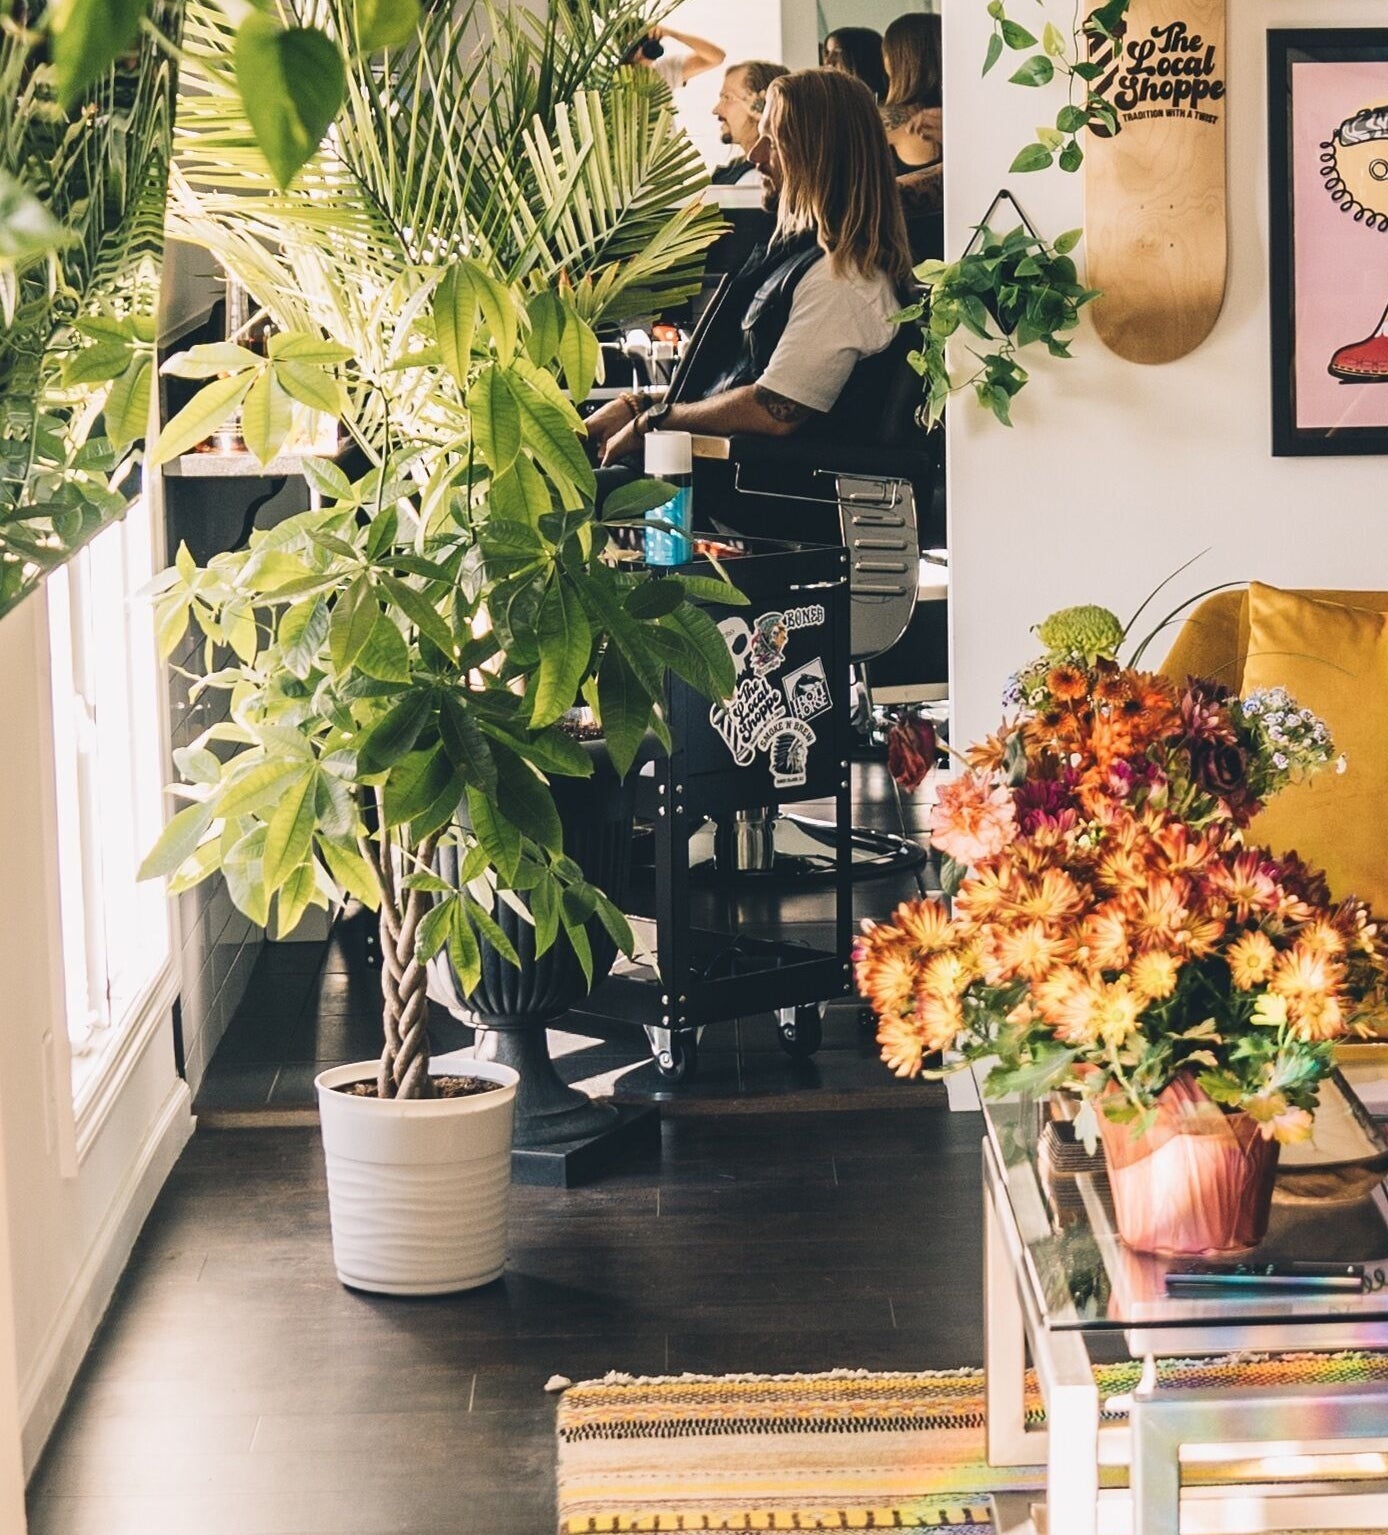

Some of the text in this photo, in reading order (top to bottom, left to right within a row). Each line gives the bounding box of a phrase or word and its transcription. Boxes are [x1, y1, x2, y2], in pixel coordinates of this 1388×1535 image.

[1151, 21, 1203, 53] The
[1126, 39, 1215, 77] Local
[1114, 75, 1226, 111] Shoppe
[1122, 108, 1218, 124] TRADITION WITH A TWIST
[733, 680, 769, 725] Local
[737, 680, 760, 703] The
[739, 691, 780, 743] Shoppe
[760, 722, 783, 747] SMOKE
[794, 722, 814, 742] BREW
